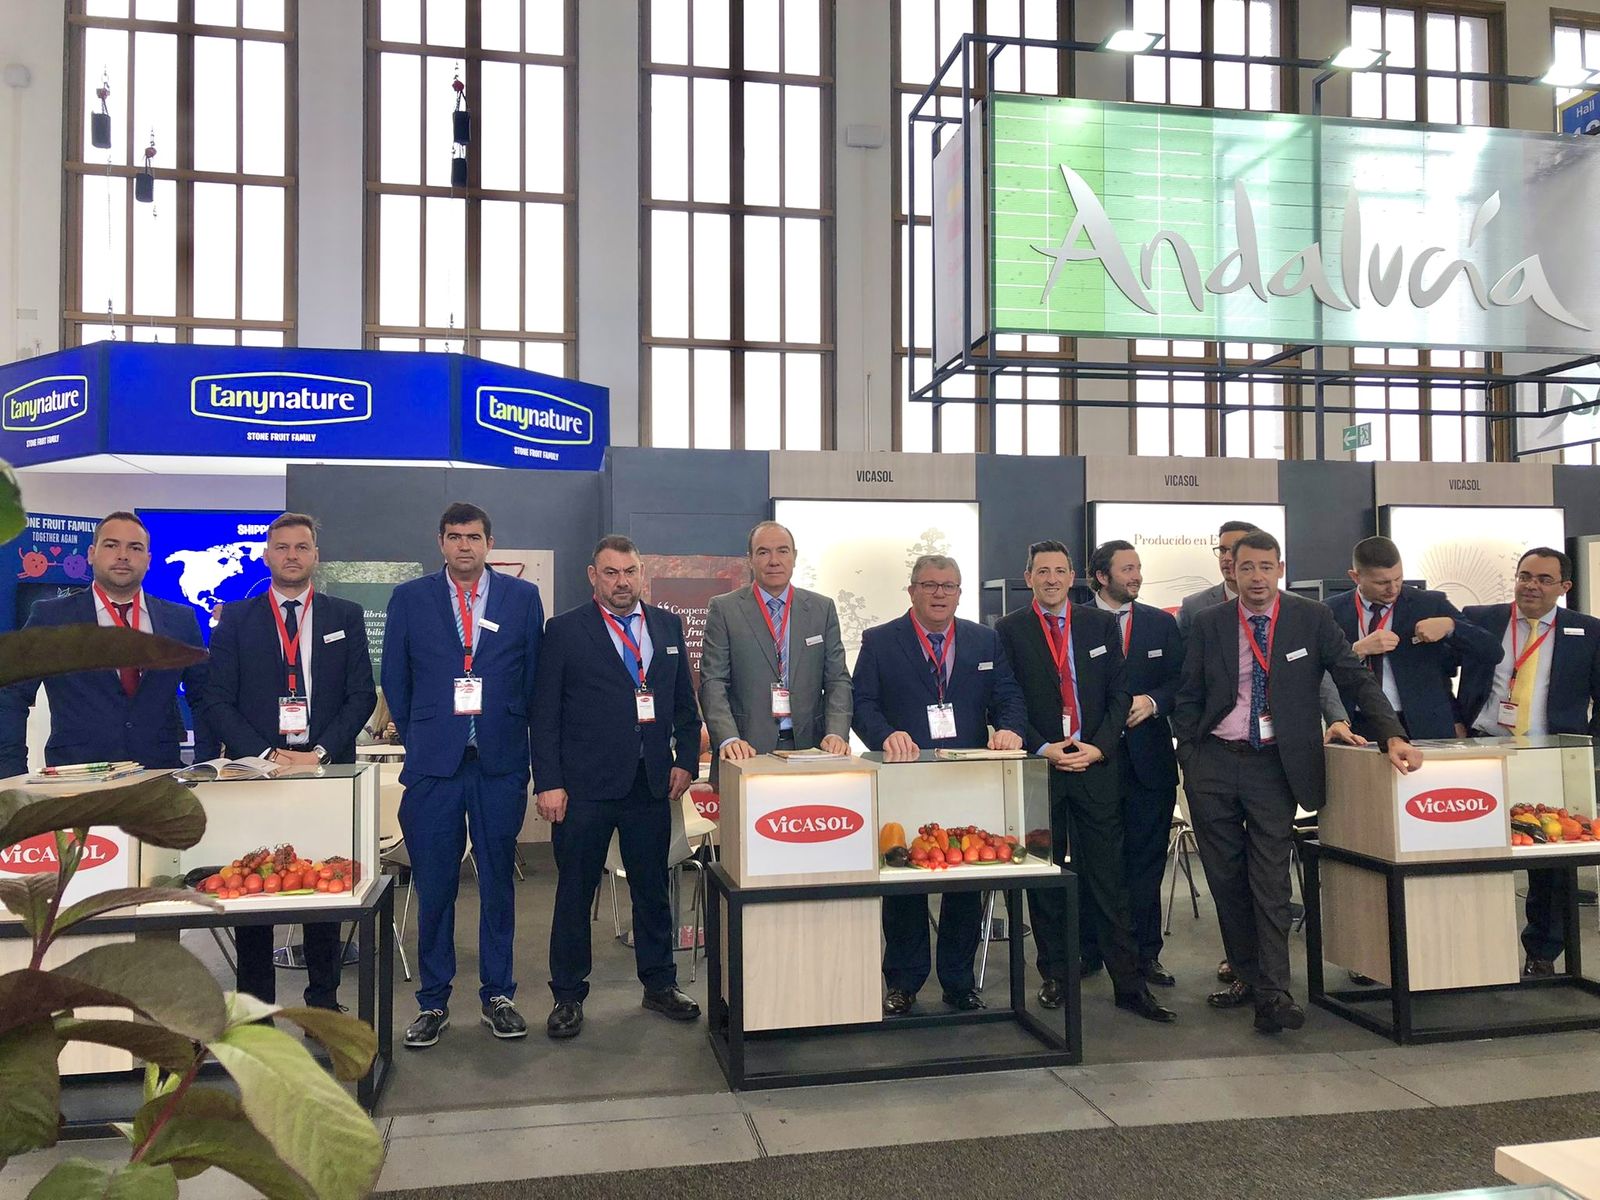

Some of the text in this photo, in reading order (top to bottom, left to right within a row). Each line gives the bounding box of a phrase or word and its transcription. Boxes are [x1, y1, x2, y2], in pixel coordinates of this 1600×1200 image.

[1576, 99, 1595, 118] Hall
[1029, 163, 1591, 331] Andalucía
[10, 389, 79, 422] tanynature
[210, 383, 355, 415] tanynature
[489, 395, 583, 434] tanynature
[246, 431, 317, 442] STONE FRUIT FAMILY
[856, 469, 894, 483] VICASOL
[1164, 474, 1199, 487] VICASOL
[1448, 479, 1481, 491] VICASOL
[25, 517, 97, 532] ONE FRUIT FAMILY
[237, 524, 270, 535] SHIPP
[32, 531, 78, 544] TOGETHER AGAIN
[1133, 533, 1192, 546] Producido
[1193, 538, 1208, 546] en
[363, 610, 387, 618] librio
